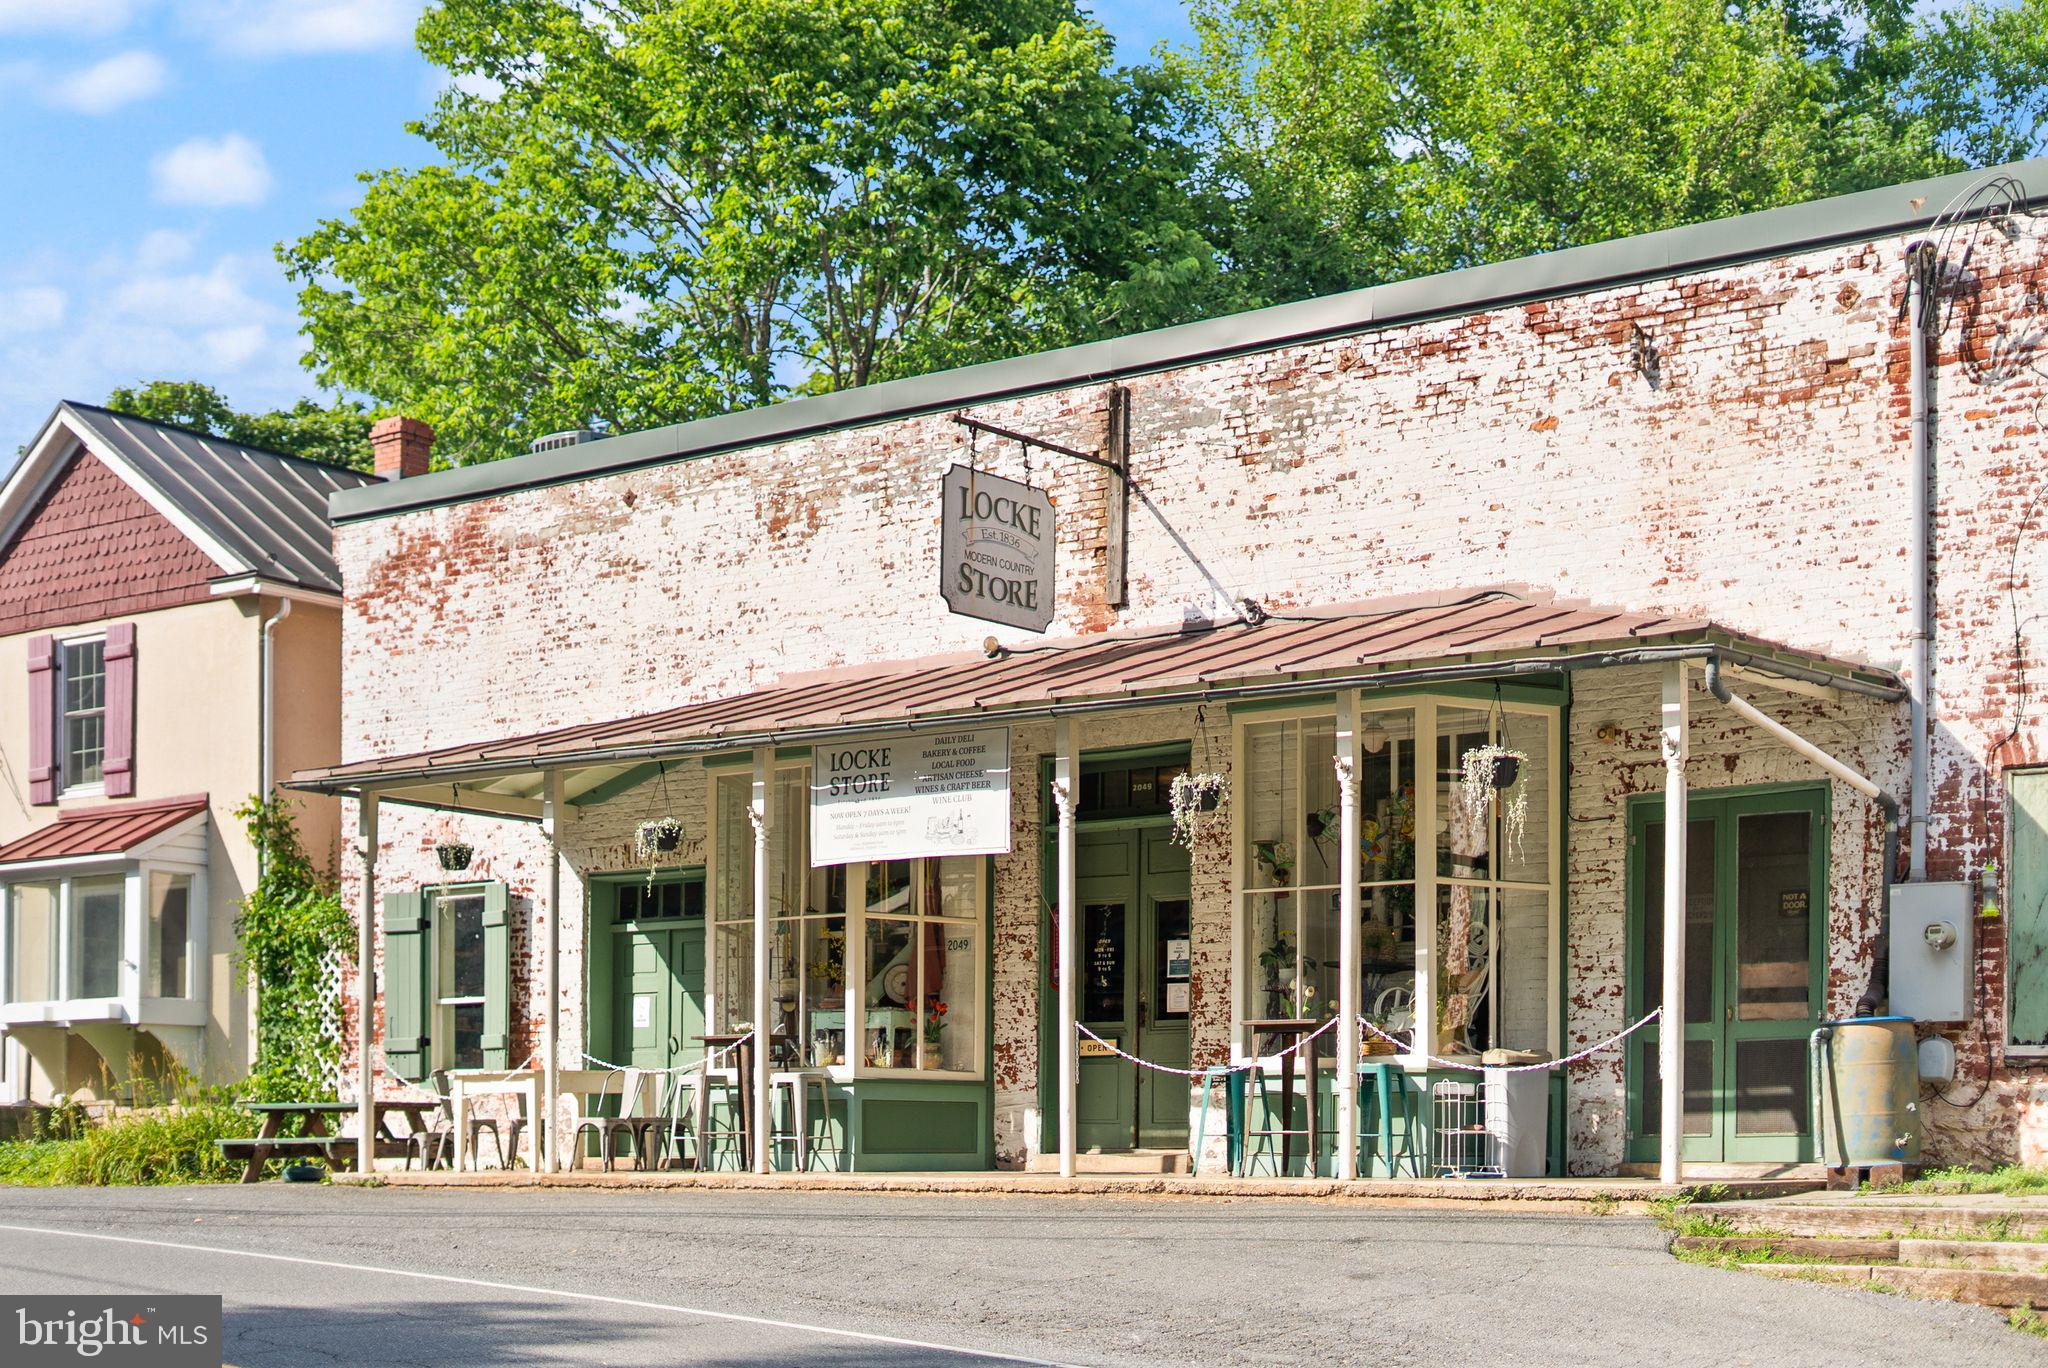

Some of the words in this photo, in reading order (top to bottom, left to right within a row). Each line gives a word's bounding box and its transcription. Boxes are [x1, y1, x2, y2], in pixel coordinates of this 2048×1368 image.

[958, 486, 1041, 541] LOCKE
[981, 528, 999, 541] Est.
[1000, 532, 1021, 548] 1836
[964, 550, 998, 567] MODERN
[999, 558, 1035, 576] COUNTRY
[958, 562, 1038, 610] STORE
[934, 736, 957, 745] DAILY
[957, 734, 975, 743] DELI
[922, 748, 951, 758] BAKERY
[952, 748, 958, 756] &
[958, 745, 986, 755] COFFEE
[830, 748, 891, 772] LOCKE
[931, 760, 955, 769] LOCAL
[956, 758, 976, 767] FOOD
[922, 772, 955, 782] ARTISAN
[955, 769, 984, 779] CHEESE
[830, 772, 891, 796] STORE
[915, 784, 939, 794] WINES
[940, 783, 946, 792] &
[946, 782, 971, 791] CRAFT
[971, 780, 991, 789] BEER
[932, 795, 951, 804] WINE
[952, 793, 972, 803] CLUB
[830, 812, 844, 820] NOW
[845, 811, 862, 819] OPEN
[868, 809, 884, 817] DAYS
[890, 805, 911, 815] WEEK!
[1782, 893, 1799, 901] NOT
[947, 939, 969, 951] 2049
[1087, 1044, 1108, 1052] OPEN
